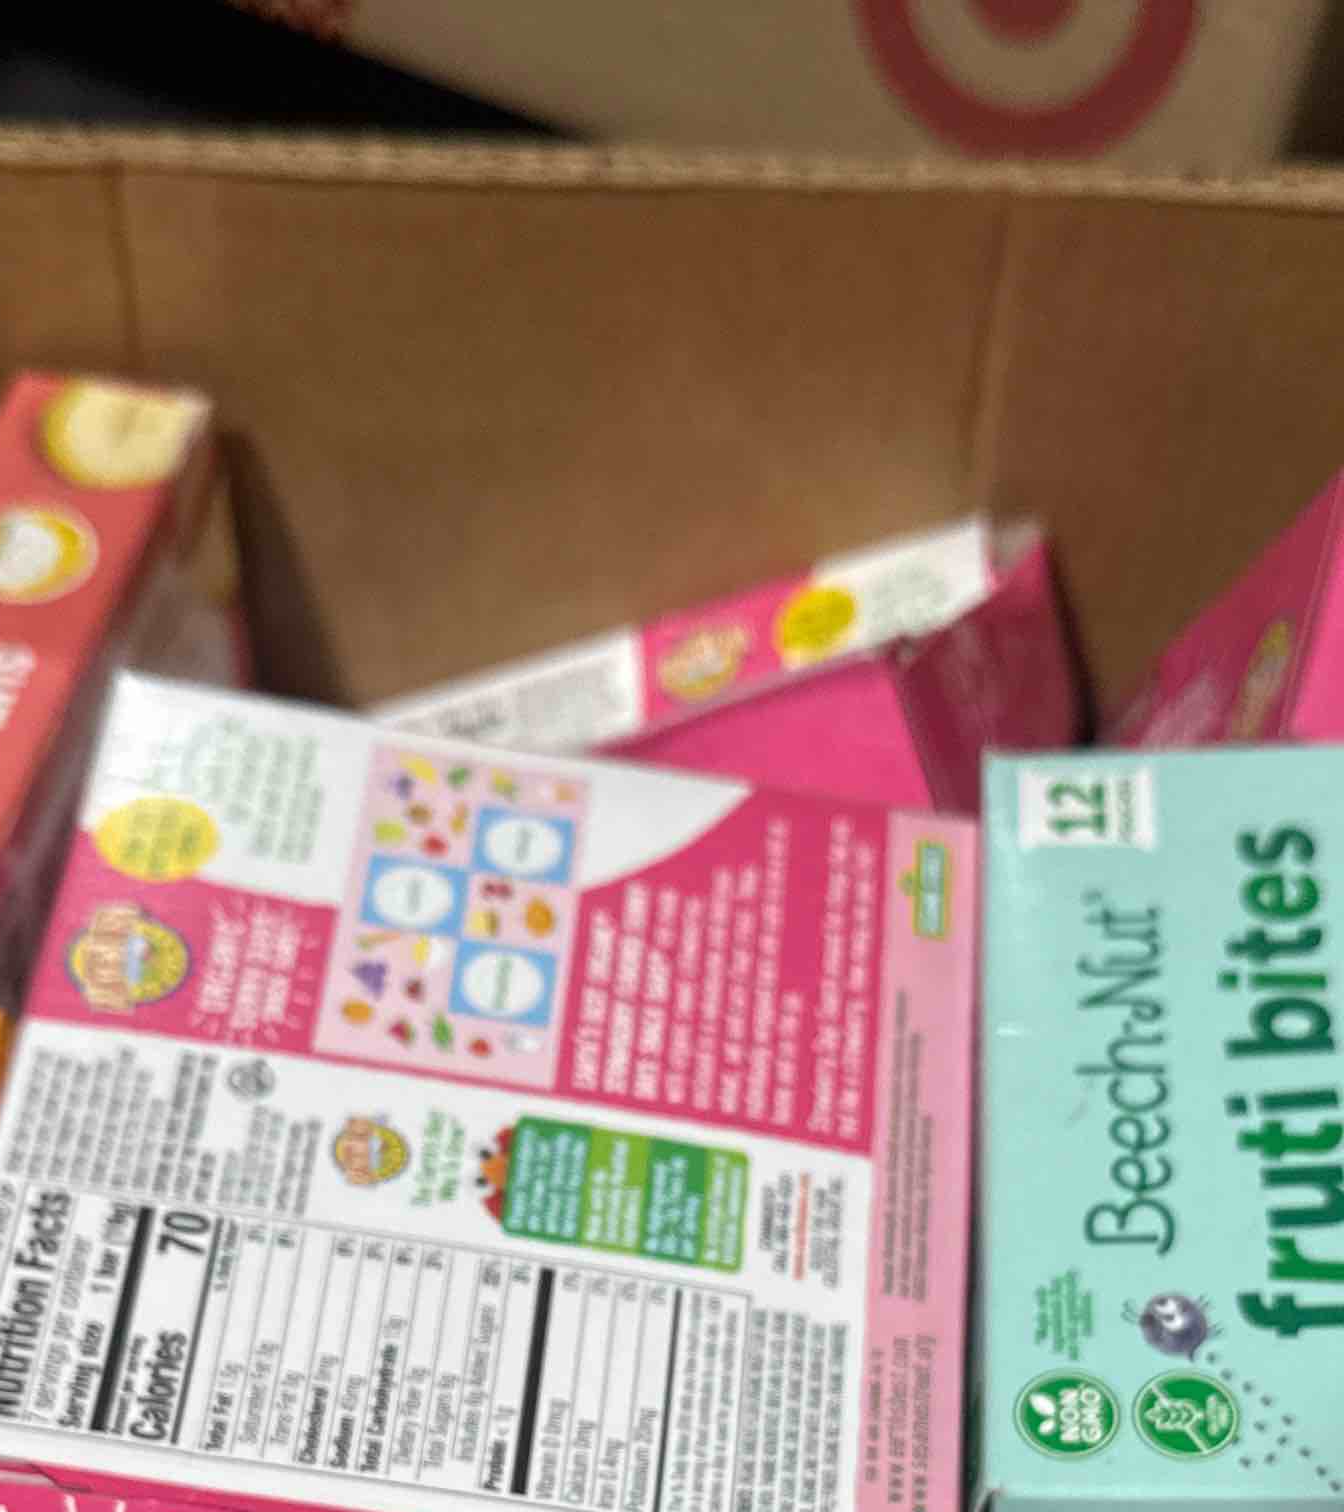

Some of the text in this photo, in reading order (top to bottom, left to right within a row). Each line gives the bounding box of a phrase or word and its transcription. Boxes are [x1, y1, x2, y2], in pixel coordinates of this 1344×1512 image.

[1047, 782, 1109, 839] 12
[1218, 822, 1336, 1058] bites
[14, 1192, 70, 1271] Facts
[158, 1211, 211, 1254] 70
[129, 1331, 186, 1440] Calories
[1059, 1388, 1080, 1443] NON
[1081, 1388, 1102, 1443] GMO
